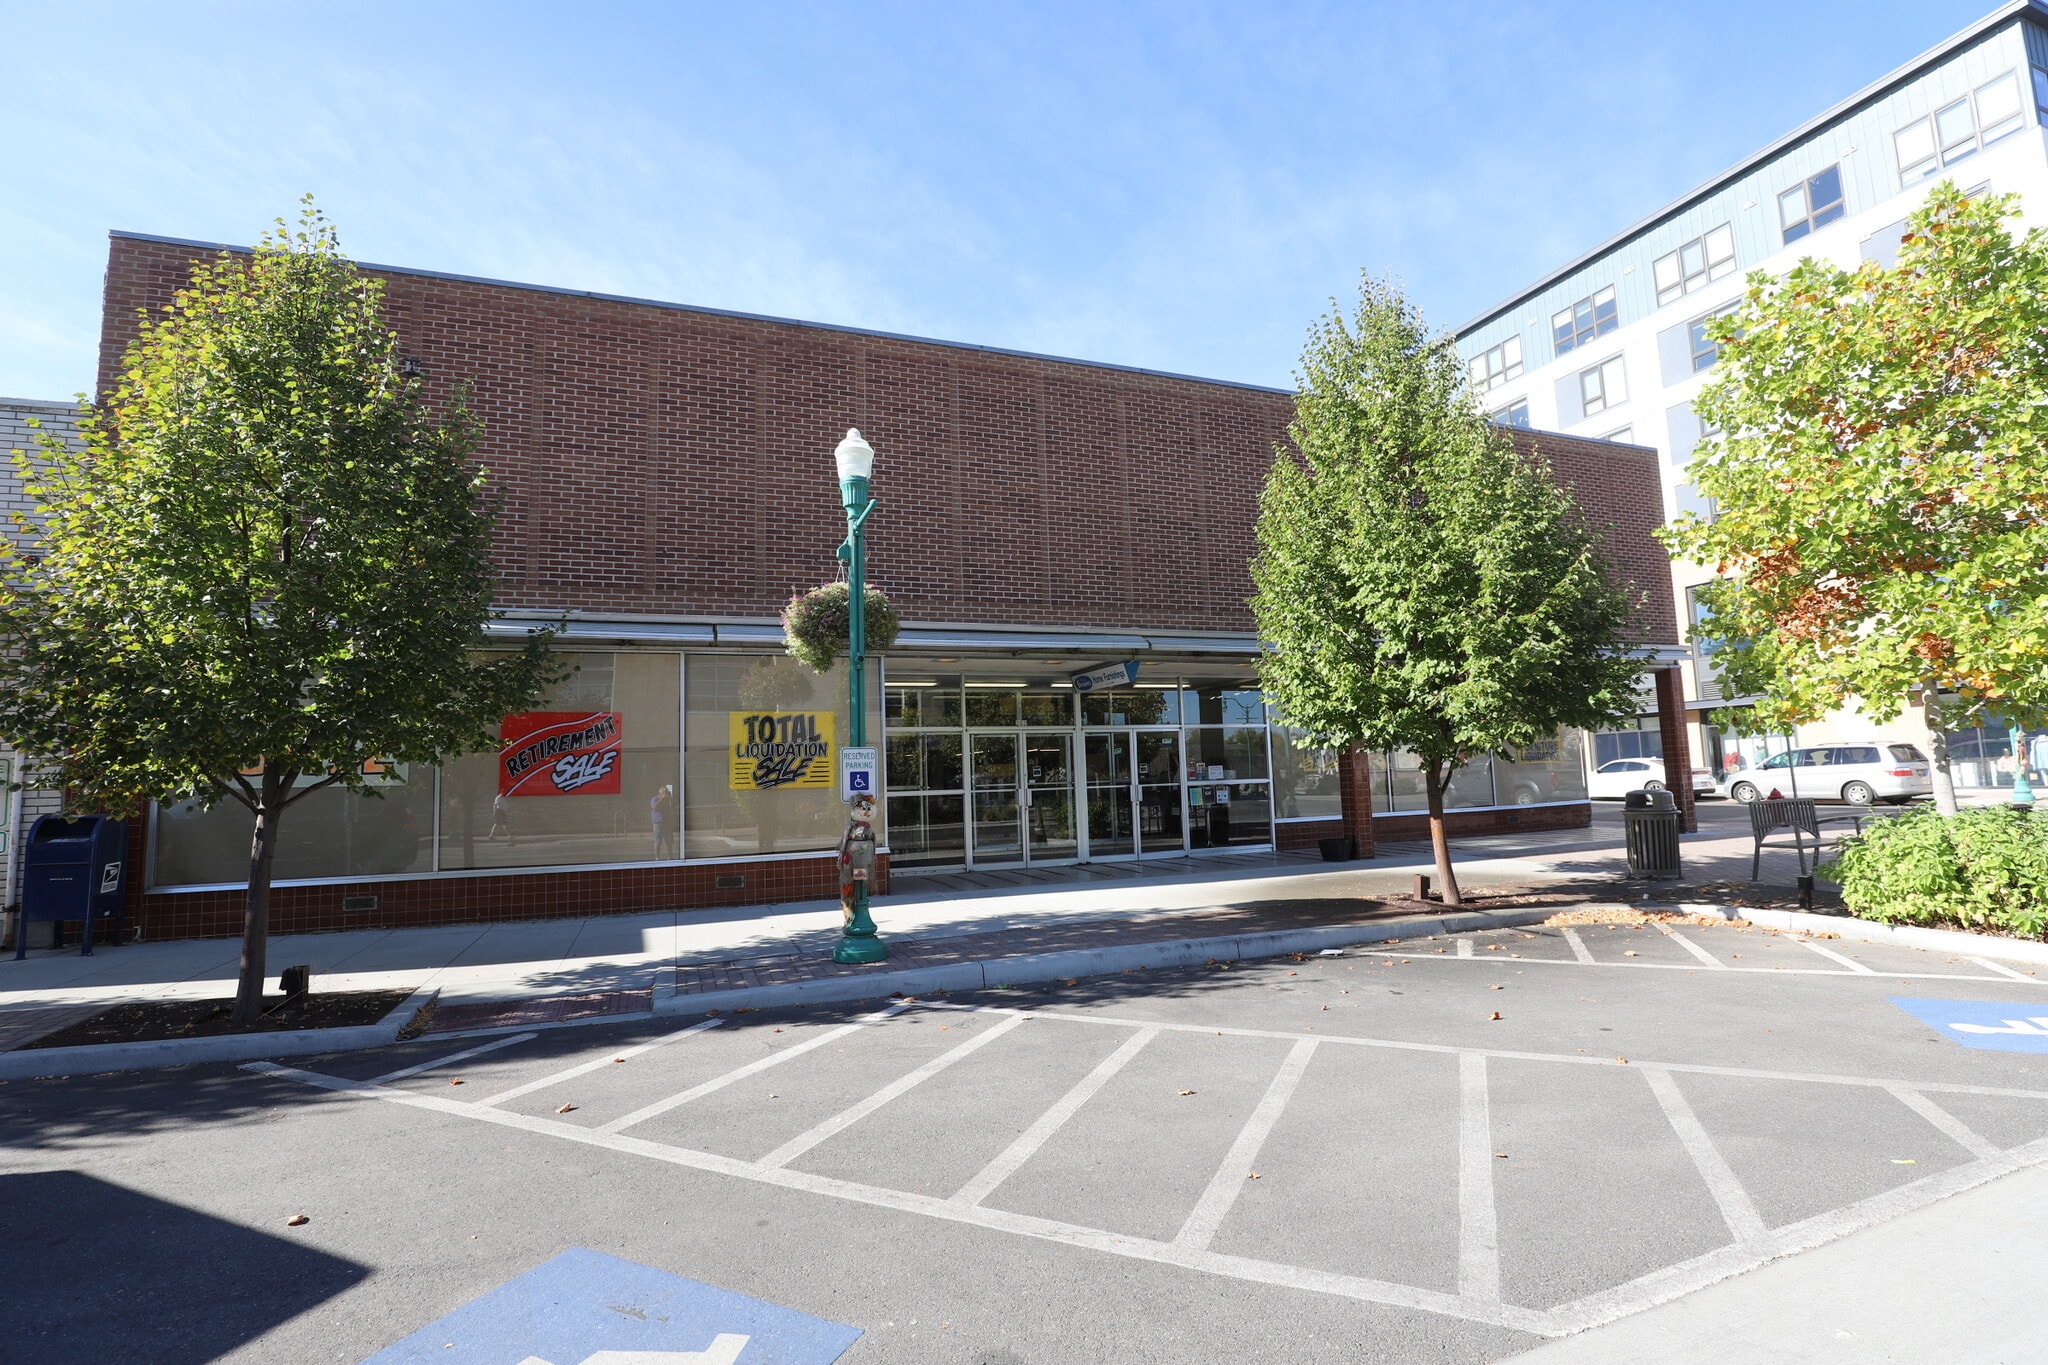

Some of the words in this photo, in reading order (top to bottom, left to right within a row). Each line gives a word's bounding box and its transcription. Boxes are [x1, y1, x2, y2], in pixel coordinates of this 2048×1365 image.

[1103, 670, 1126, 681] Furnishings
[743, 714, 821, 743] TOTAL
[505, 715, 616, 778] RETIREMENT
[736, 742, 828, 759] LIQUIDATION
[844, 752, 875, 760] RESERVED
[551, 751, 618, 788] SALE
[753, 757, 813, 787] SALE
